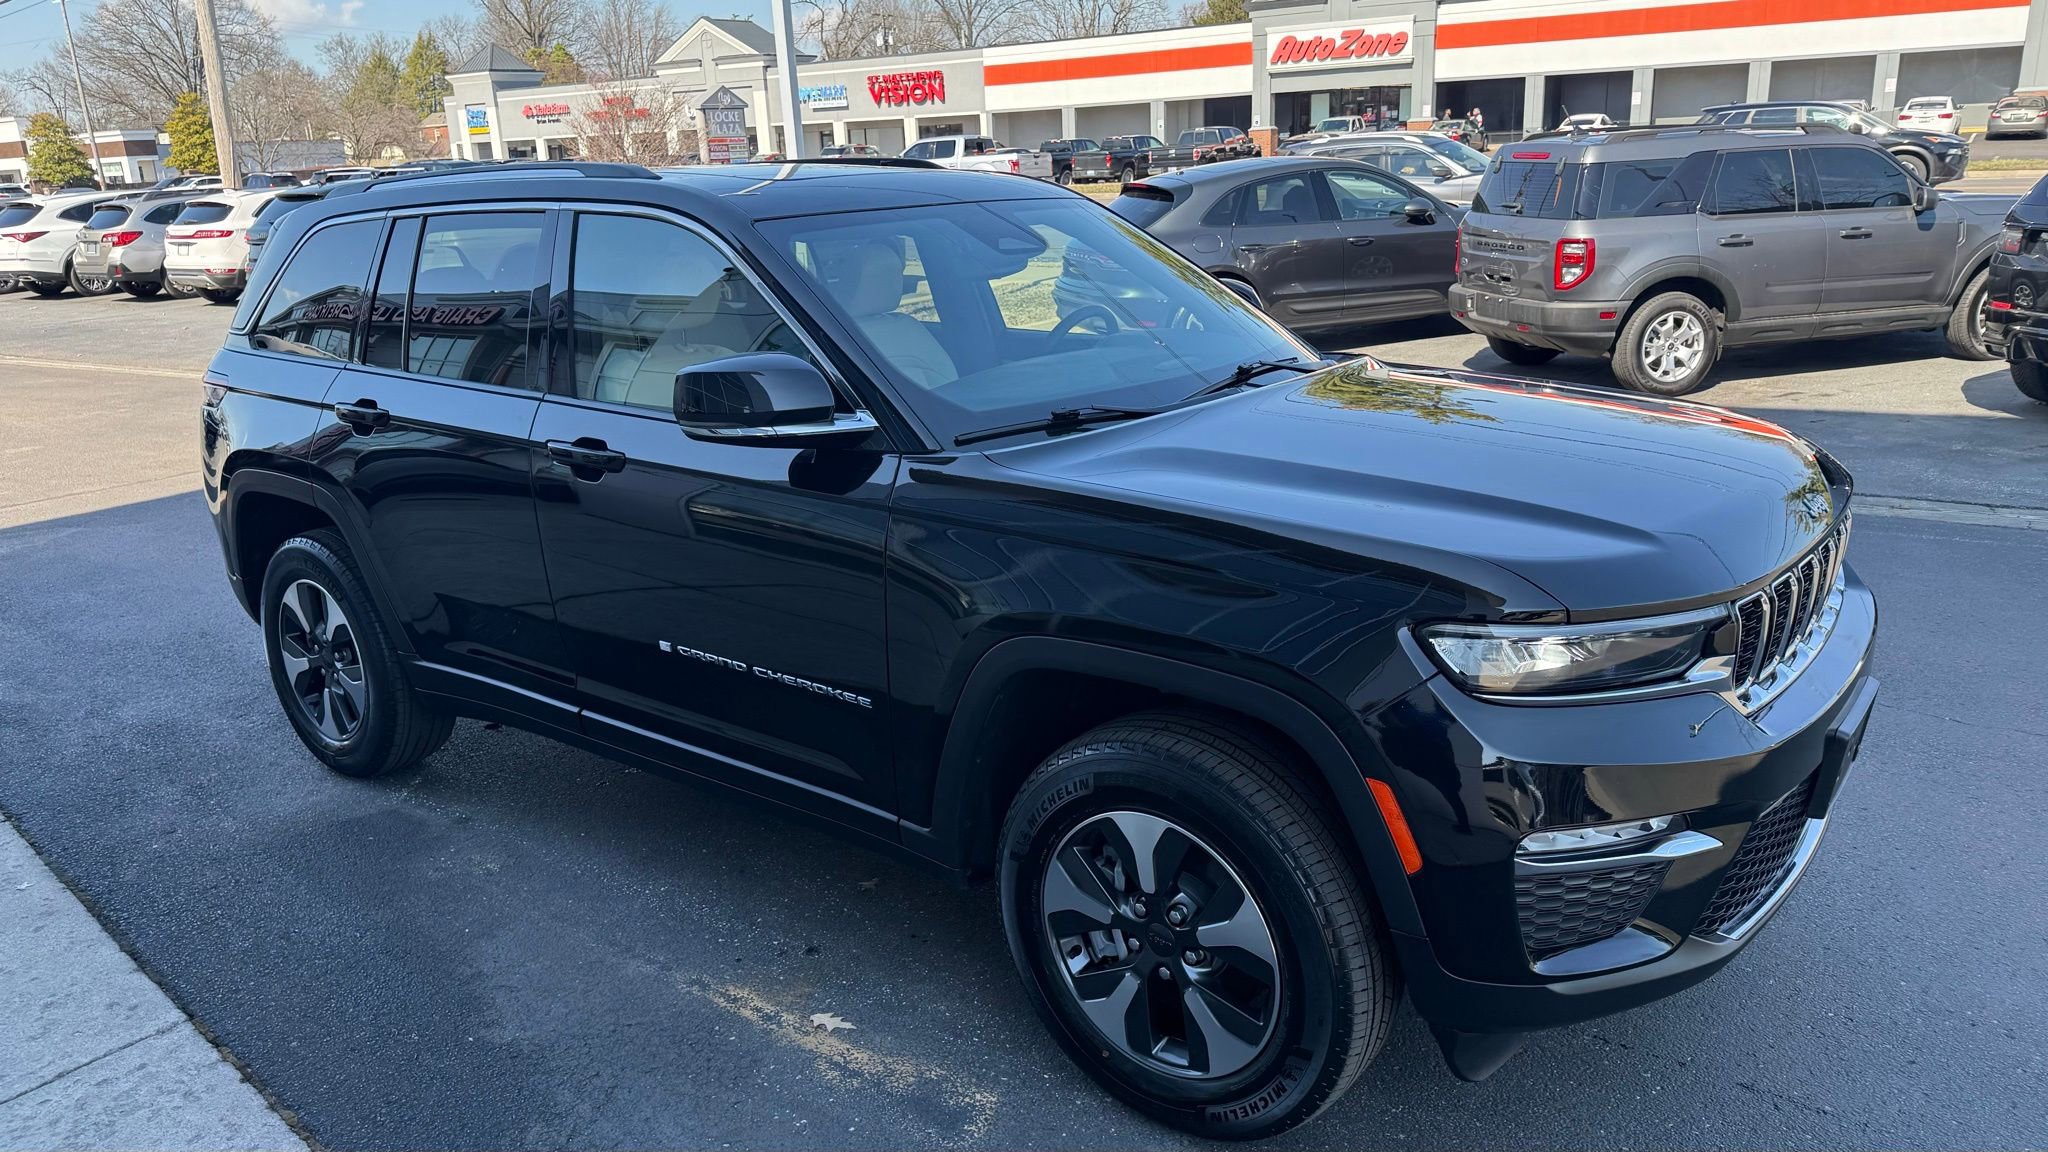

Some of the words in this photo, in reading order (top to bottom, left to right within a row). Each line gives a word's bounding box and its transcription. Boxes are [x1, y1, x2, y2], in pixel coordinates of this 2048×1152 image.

[1270, 29, 1409, 65] AutoZone
[868, 82, 945, 106] VISION
[710, 111, 740, 122] LOCKE
[1477, 240, 1525, 251] BRONCO
[677, 645, 747, 672] GRAND
[753, 666, 873, 709] CHEROKEE
[1026, 777, 1090, 830] MICHELIN
[1208, 1080, 1288, 1123] MICHELIN
